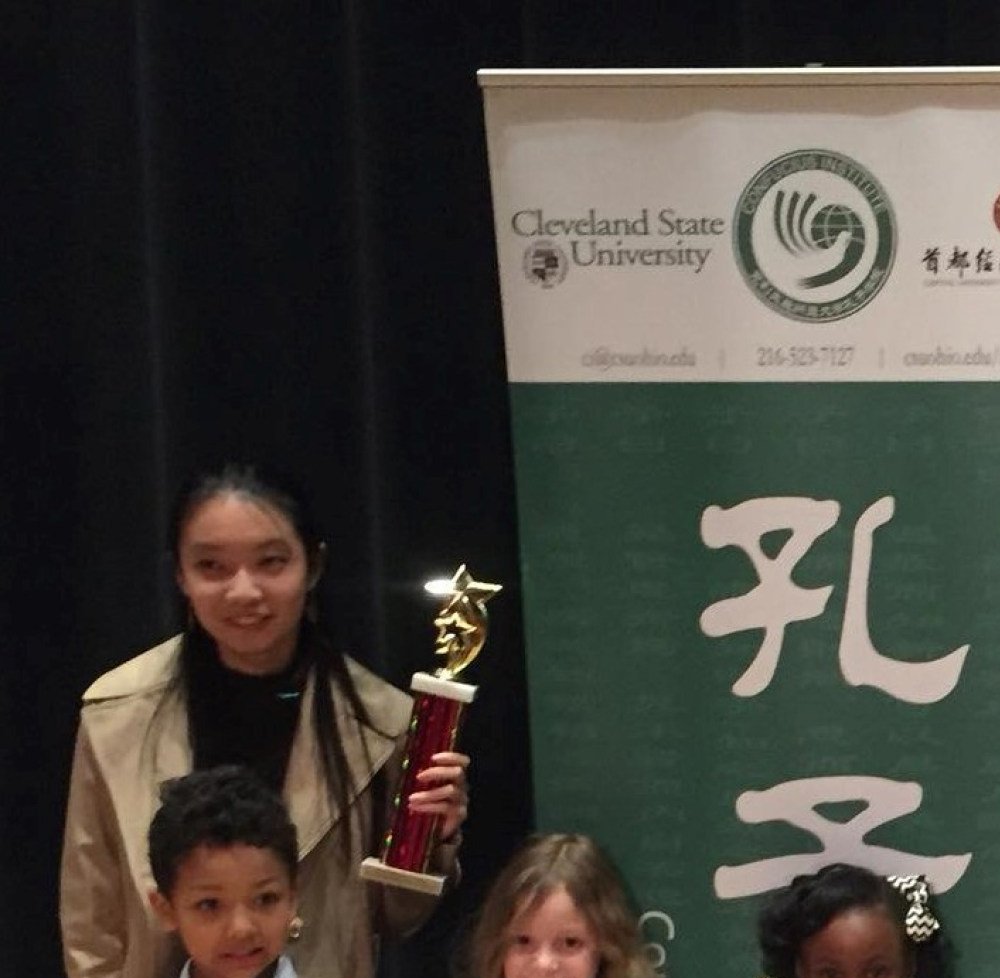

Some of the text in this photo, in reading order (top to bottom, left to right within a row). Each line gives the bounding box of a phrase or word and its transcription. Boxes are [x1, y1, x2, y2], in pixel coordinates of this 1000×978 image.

[511, 208, 725, 237] Cleveland State
[570, 240, 711, 273] University
